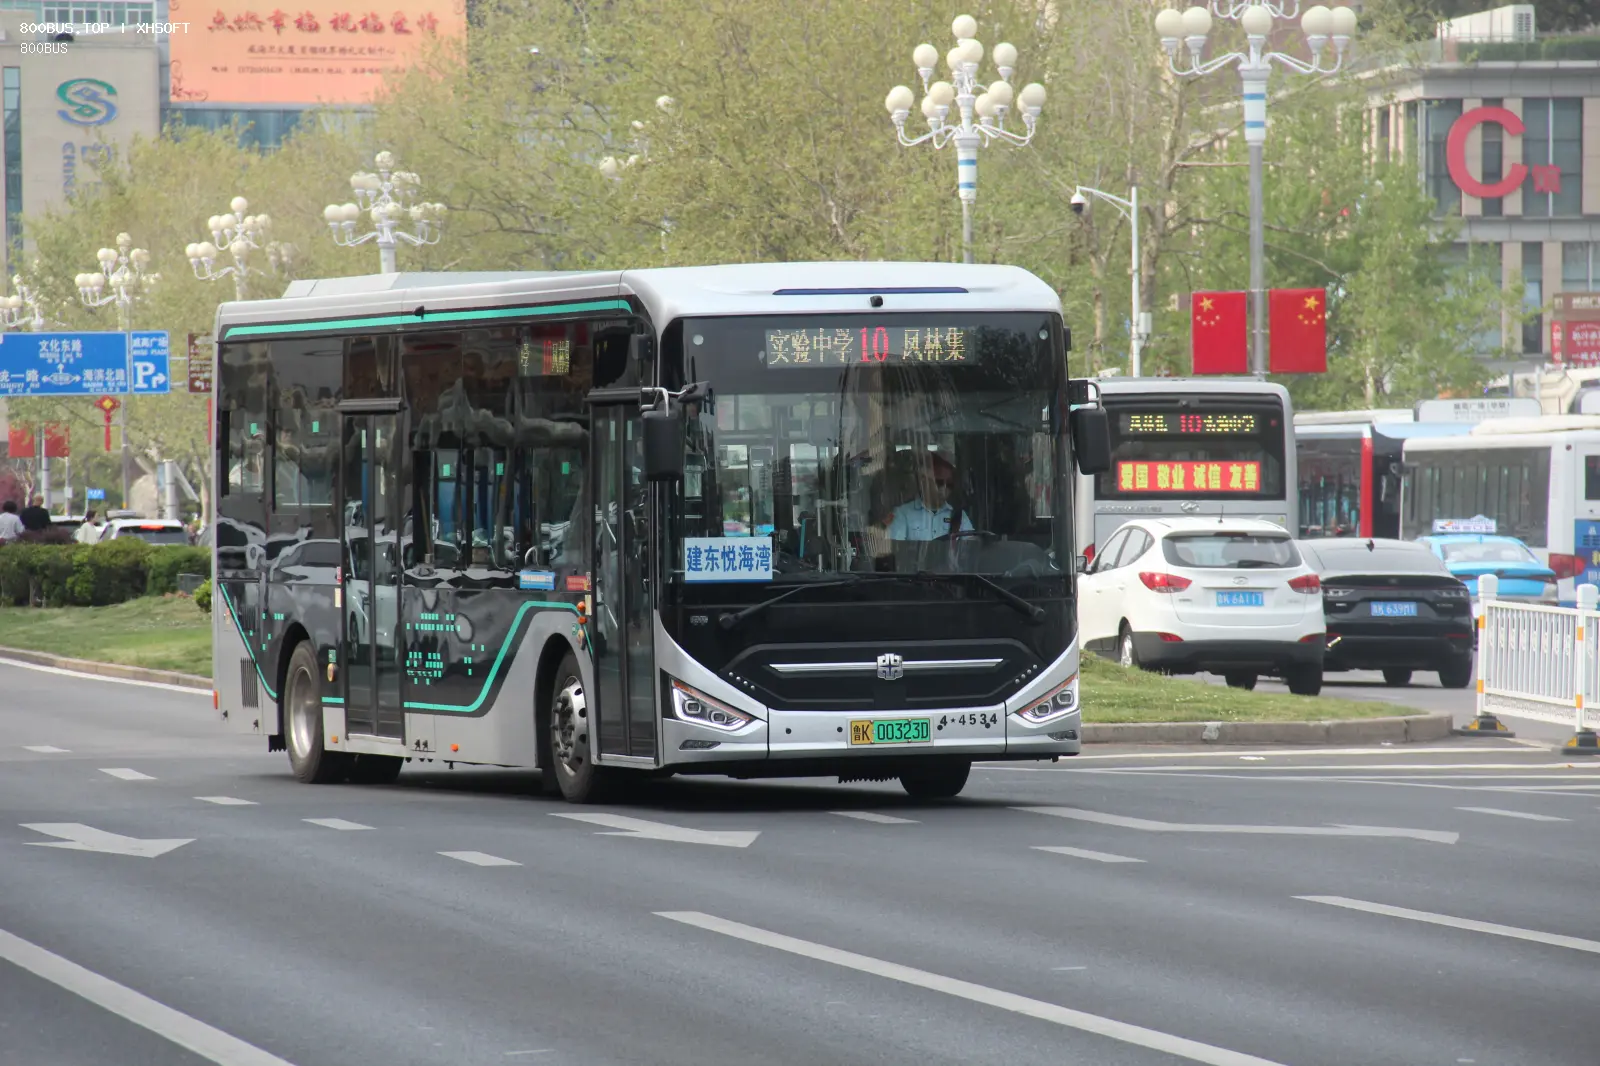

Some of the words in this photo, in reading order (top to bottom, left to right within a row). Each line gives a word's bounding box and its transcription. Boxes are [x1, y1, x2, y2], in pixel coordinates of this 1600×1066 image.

[38, 338, 83, 352] 文化东路
[769, 327, 854, 365] 实验中学
[859, 326, 889, 363] 10
[902, 327, 966, 361] 风林集
[686, 544, 771, 572] 建东悦海湾
